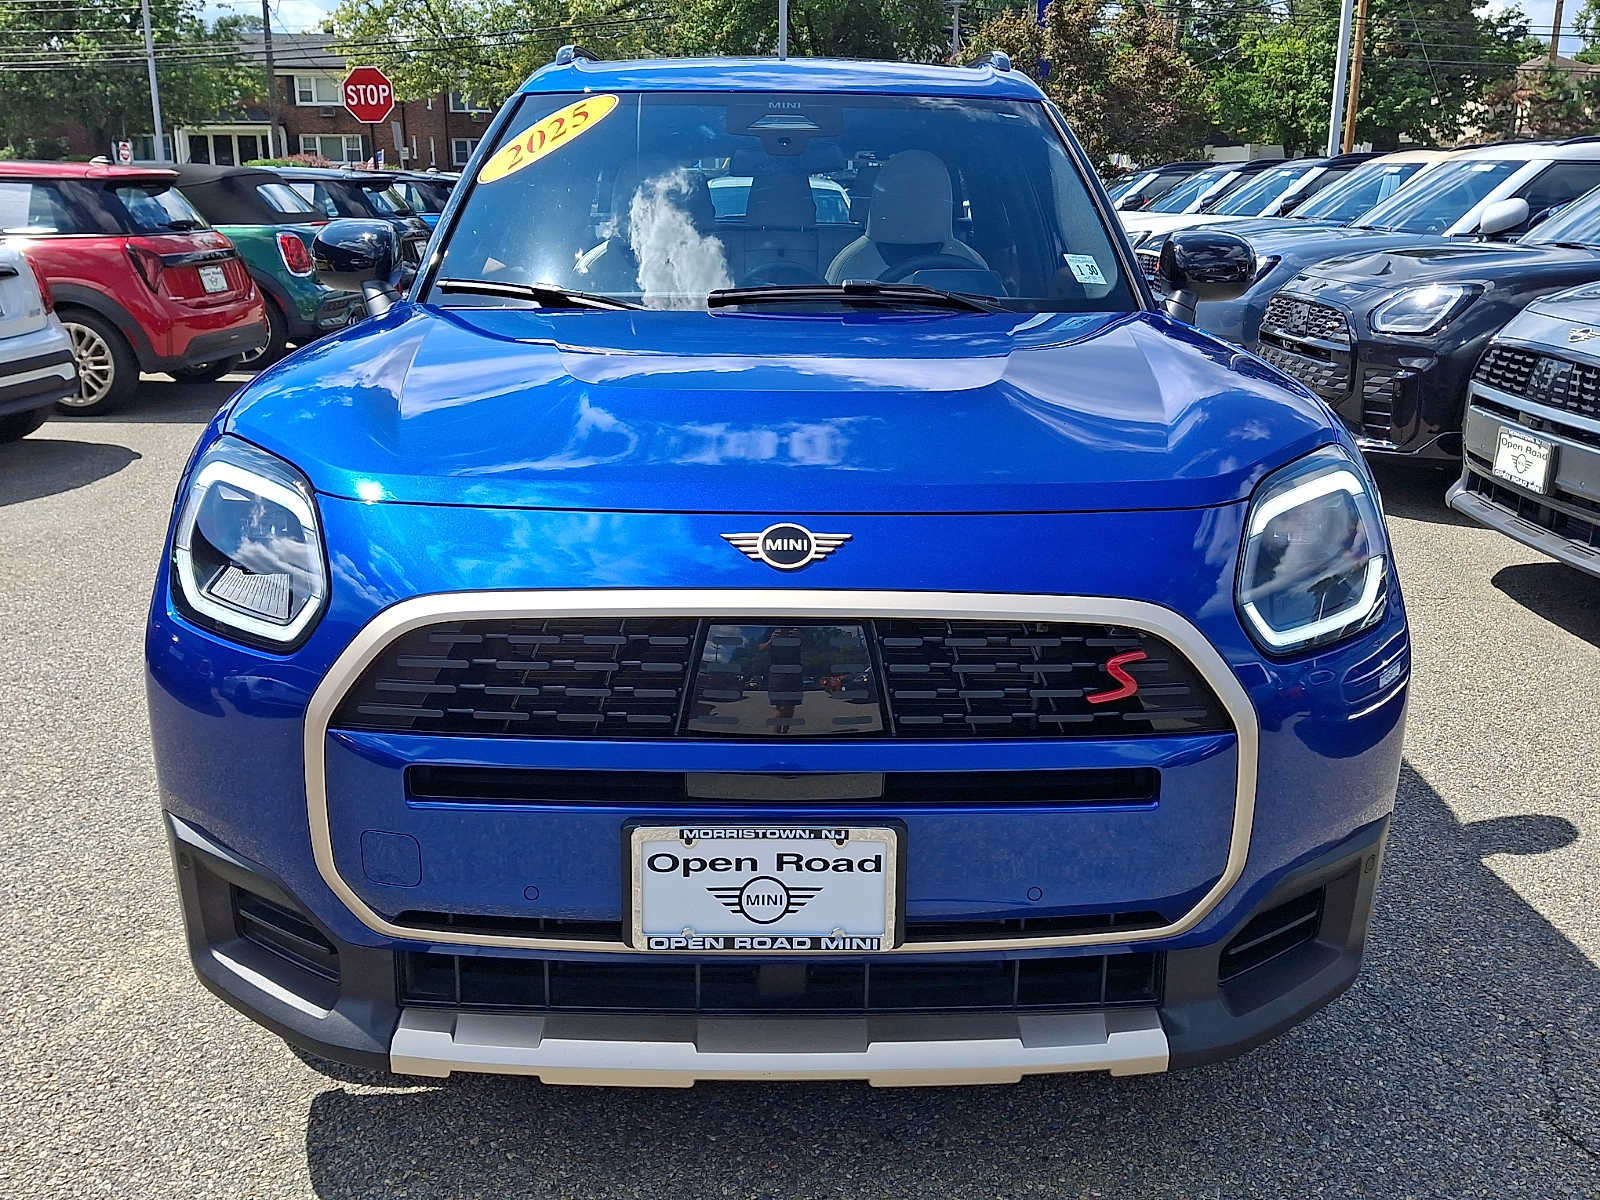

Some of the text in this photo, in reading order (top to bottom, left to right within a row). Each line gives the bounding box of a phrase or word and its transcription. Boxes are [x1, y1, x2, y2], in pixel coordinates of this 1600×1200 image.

[346, 84, 390, 106] STOP
[507, 103, 589, 171] 2025
[1076, 263, 1099, 276] 1 30
[1501, 437, 1523, 452] Open
[1525, 445, 1548, 461] Road
[765, 538, 808, 551] MINI
[1086, 650, 1148, 704] S
[821, 829, 846, 840] NJ
[646, 852, 882, 878] Open Road
[745, 894, 783, 906] MINI
[649, 937, 879, 950] OPEN ROAD MINI
